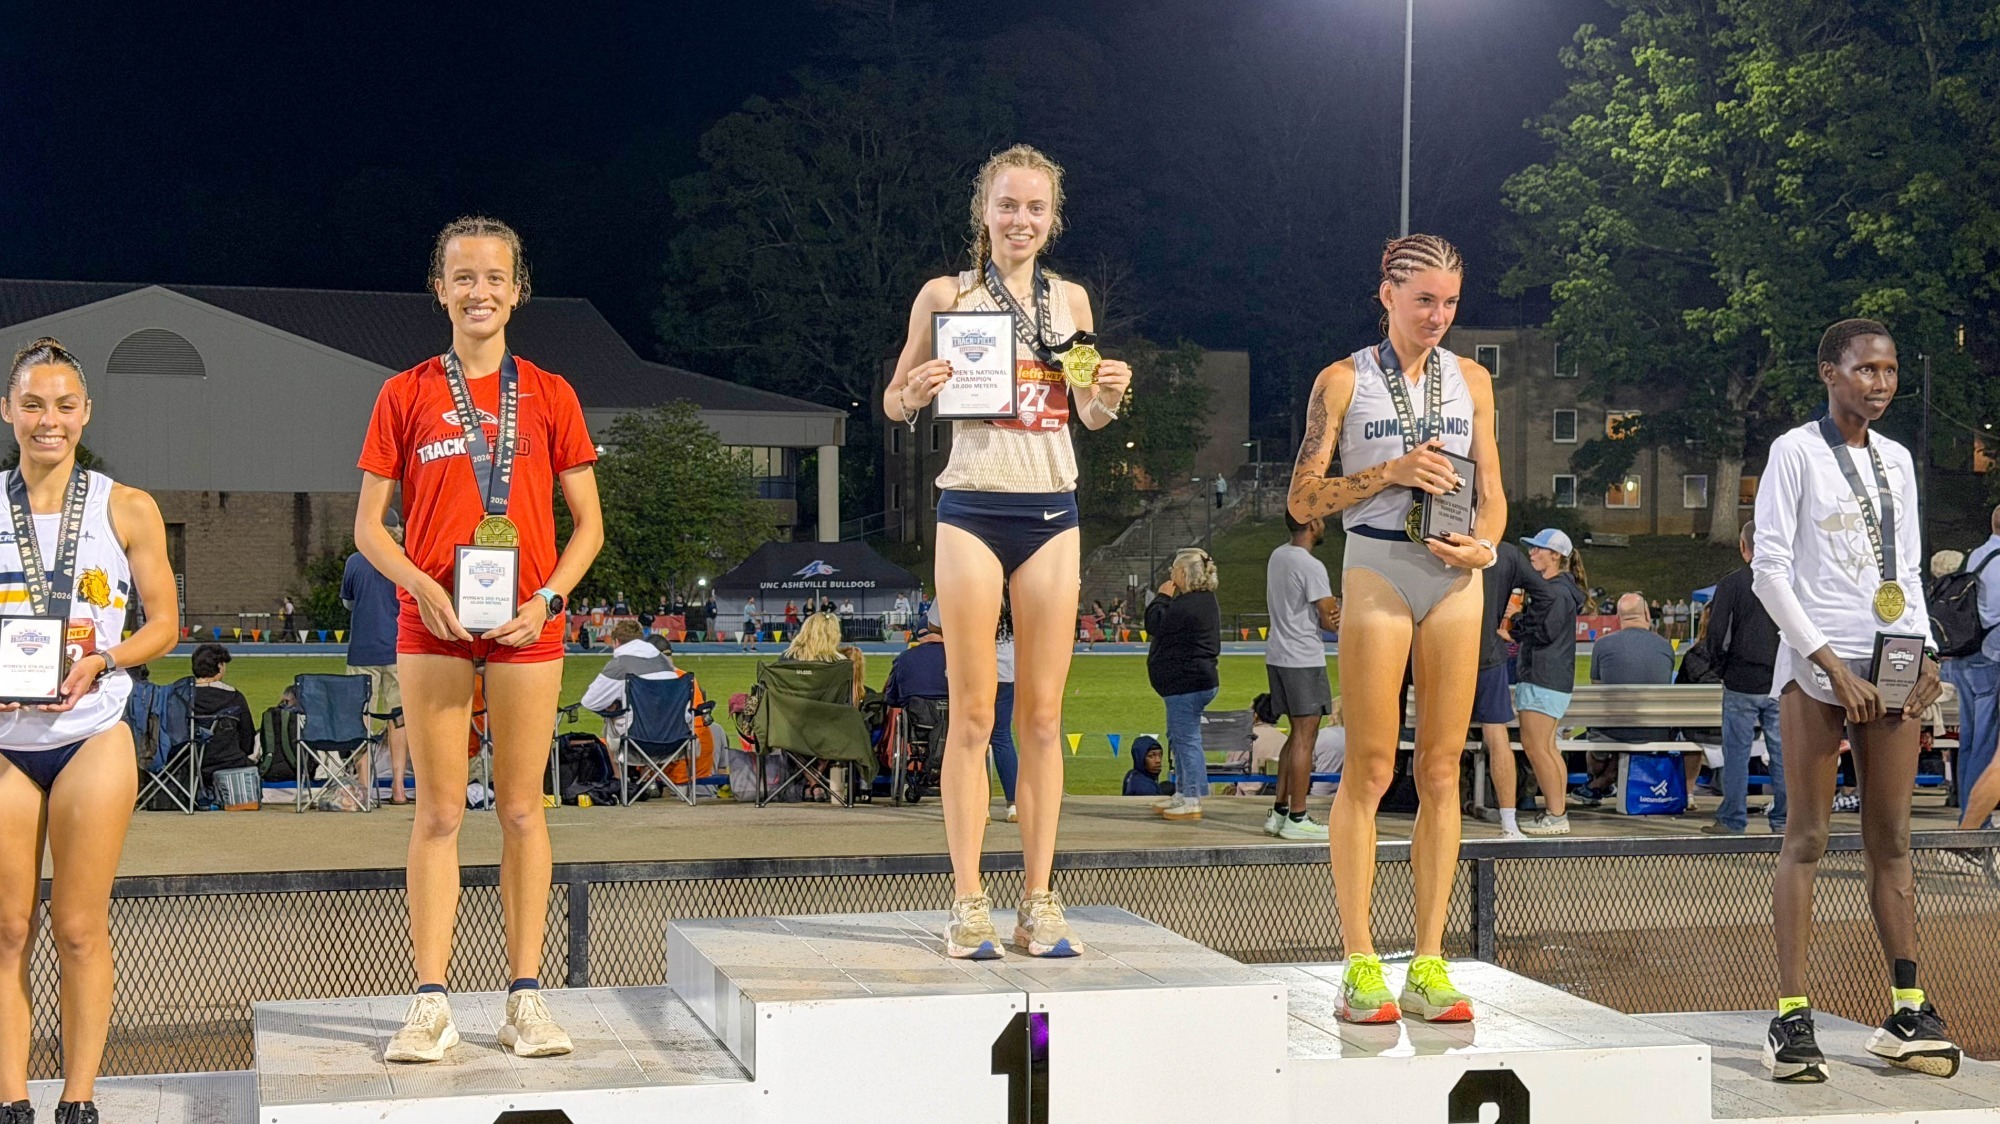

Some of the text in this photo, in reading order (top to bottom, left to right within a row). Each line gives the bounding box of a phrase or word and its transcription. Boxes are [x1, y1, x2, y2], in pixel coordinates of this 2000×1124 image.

[501, 382, 517, 483] ALL-AMERICAN
[1017, 383, 1050, 412] 27
[1386, 368, 1414, 452] ALL-AMERICA
[1431, 355, 1440, 434] LL-AMERICAN
[416, 438, 467, 464] TRACK
[472, 454, 491, 463] 2026
[63, 473, 88, 576] ALL-AMERICAN
[490, 497, 508, 505] 2026
[12, 504, 45, 614] ALL-AMERICAN
[991, 1012, 1049, 1124] 1
